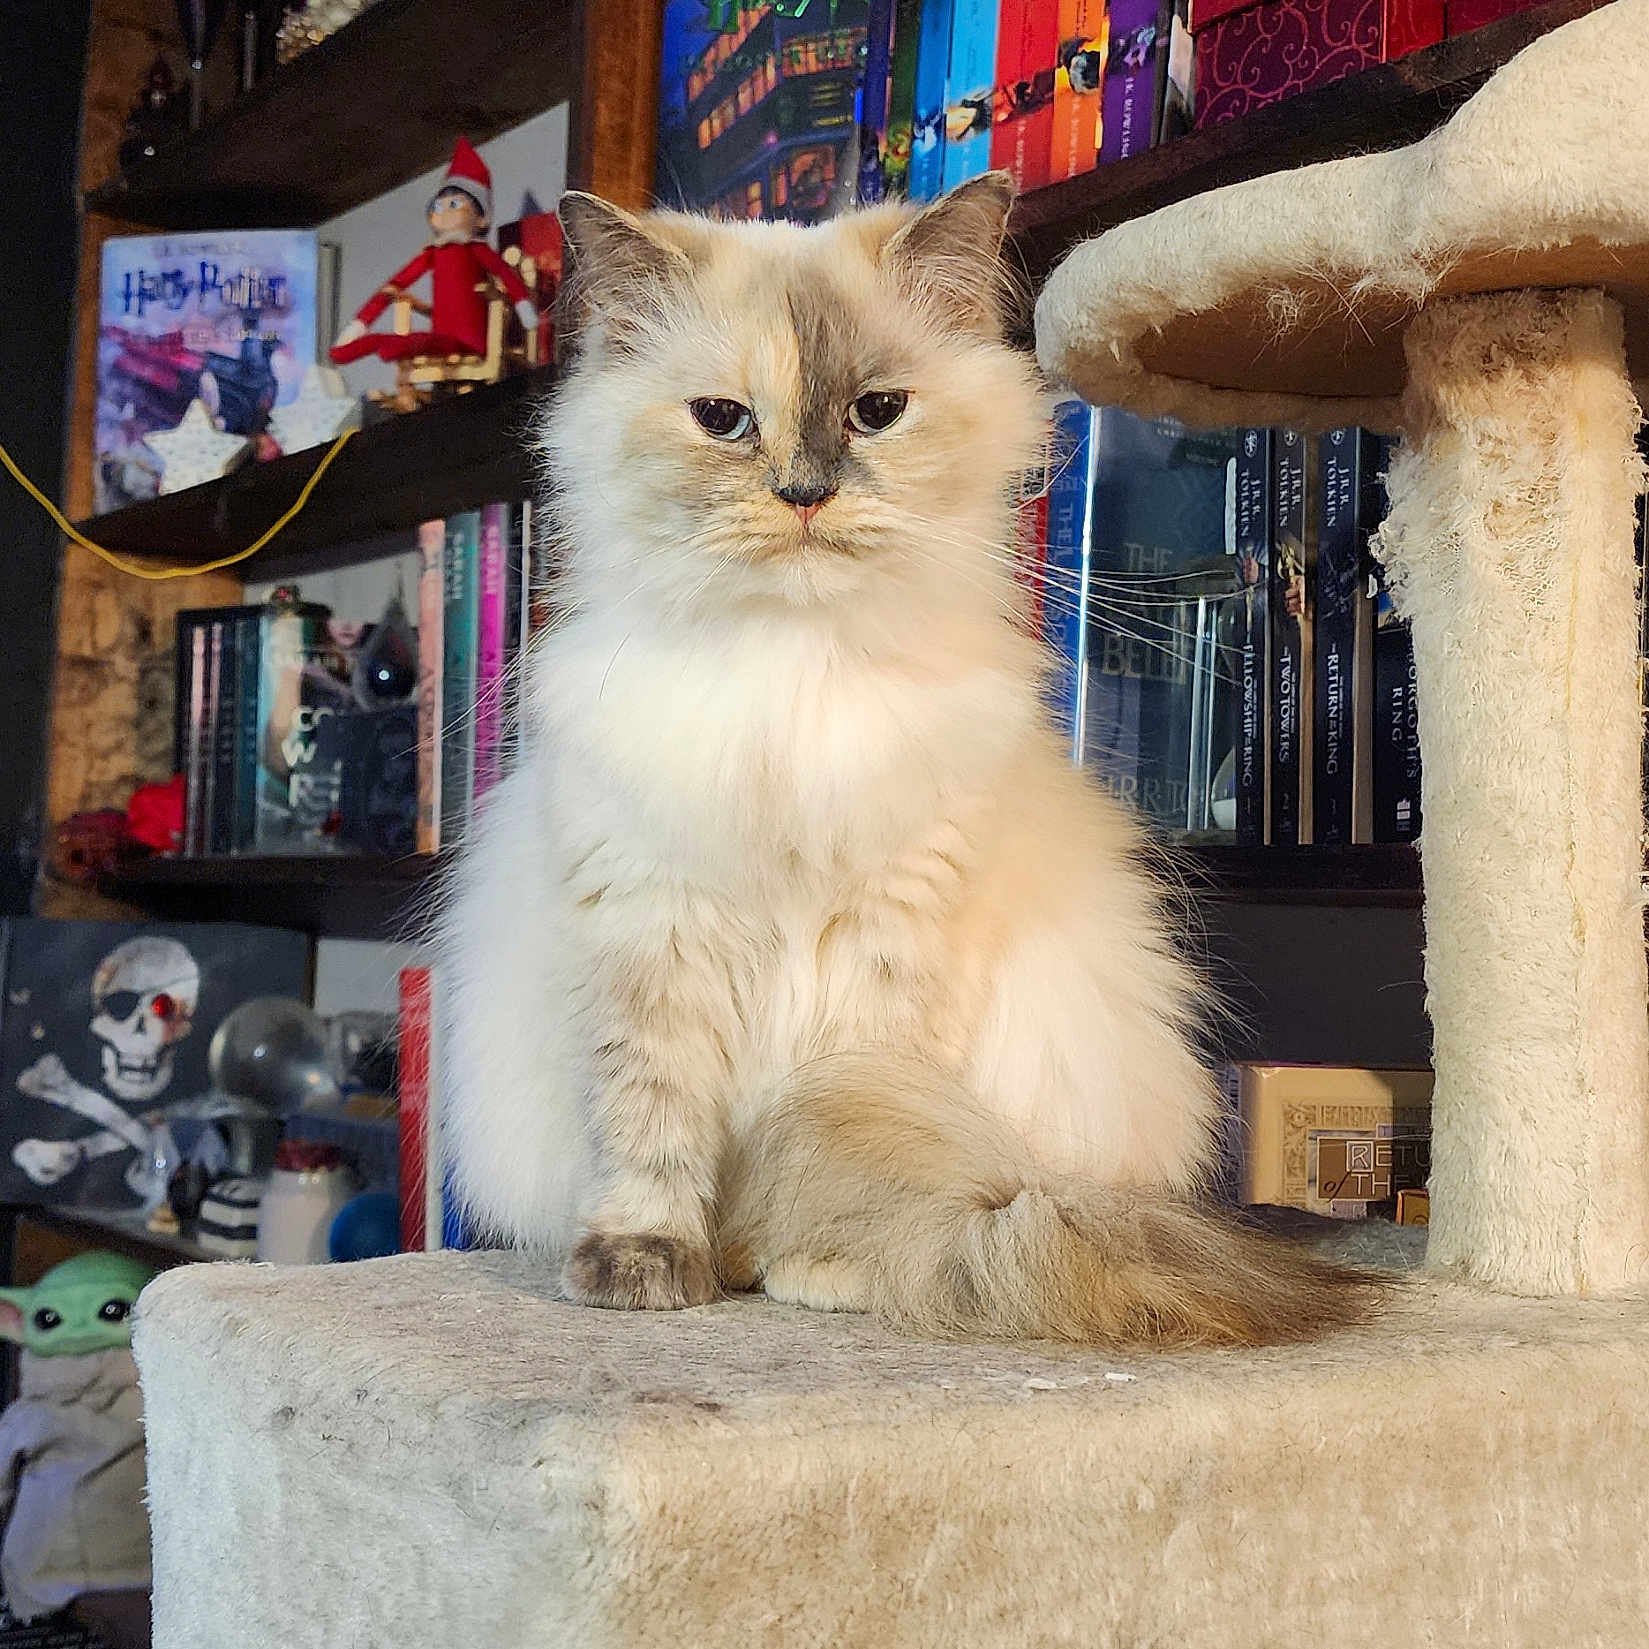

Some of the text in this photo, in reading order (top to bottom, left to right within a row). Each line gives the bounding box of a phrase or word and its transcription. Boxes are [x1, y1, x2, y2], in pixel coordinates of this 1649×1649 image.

[1241, 468, 1249, 536] TOLKIEN
[1279, 457, 1289, 527] TOLKIEN
[1327, 457, 1337, 527] TOLKIEN
[1279, 655, 1291, 763] TWO TOWERS
[1326, 653, 1339, 718] RETURN
[1391, 687, 1402, 742] RING
[1242, 746, 1253, 787] RING
[1326, 730, 1338, 775] KING
